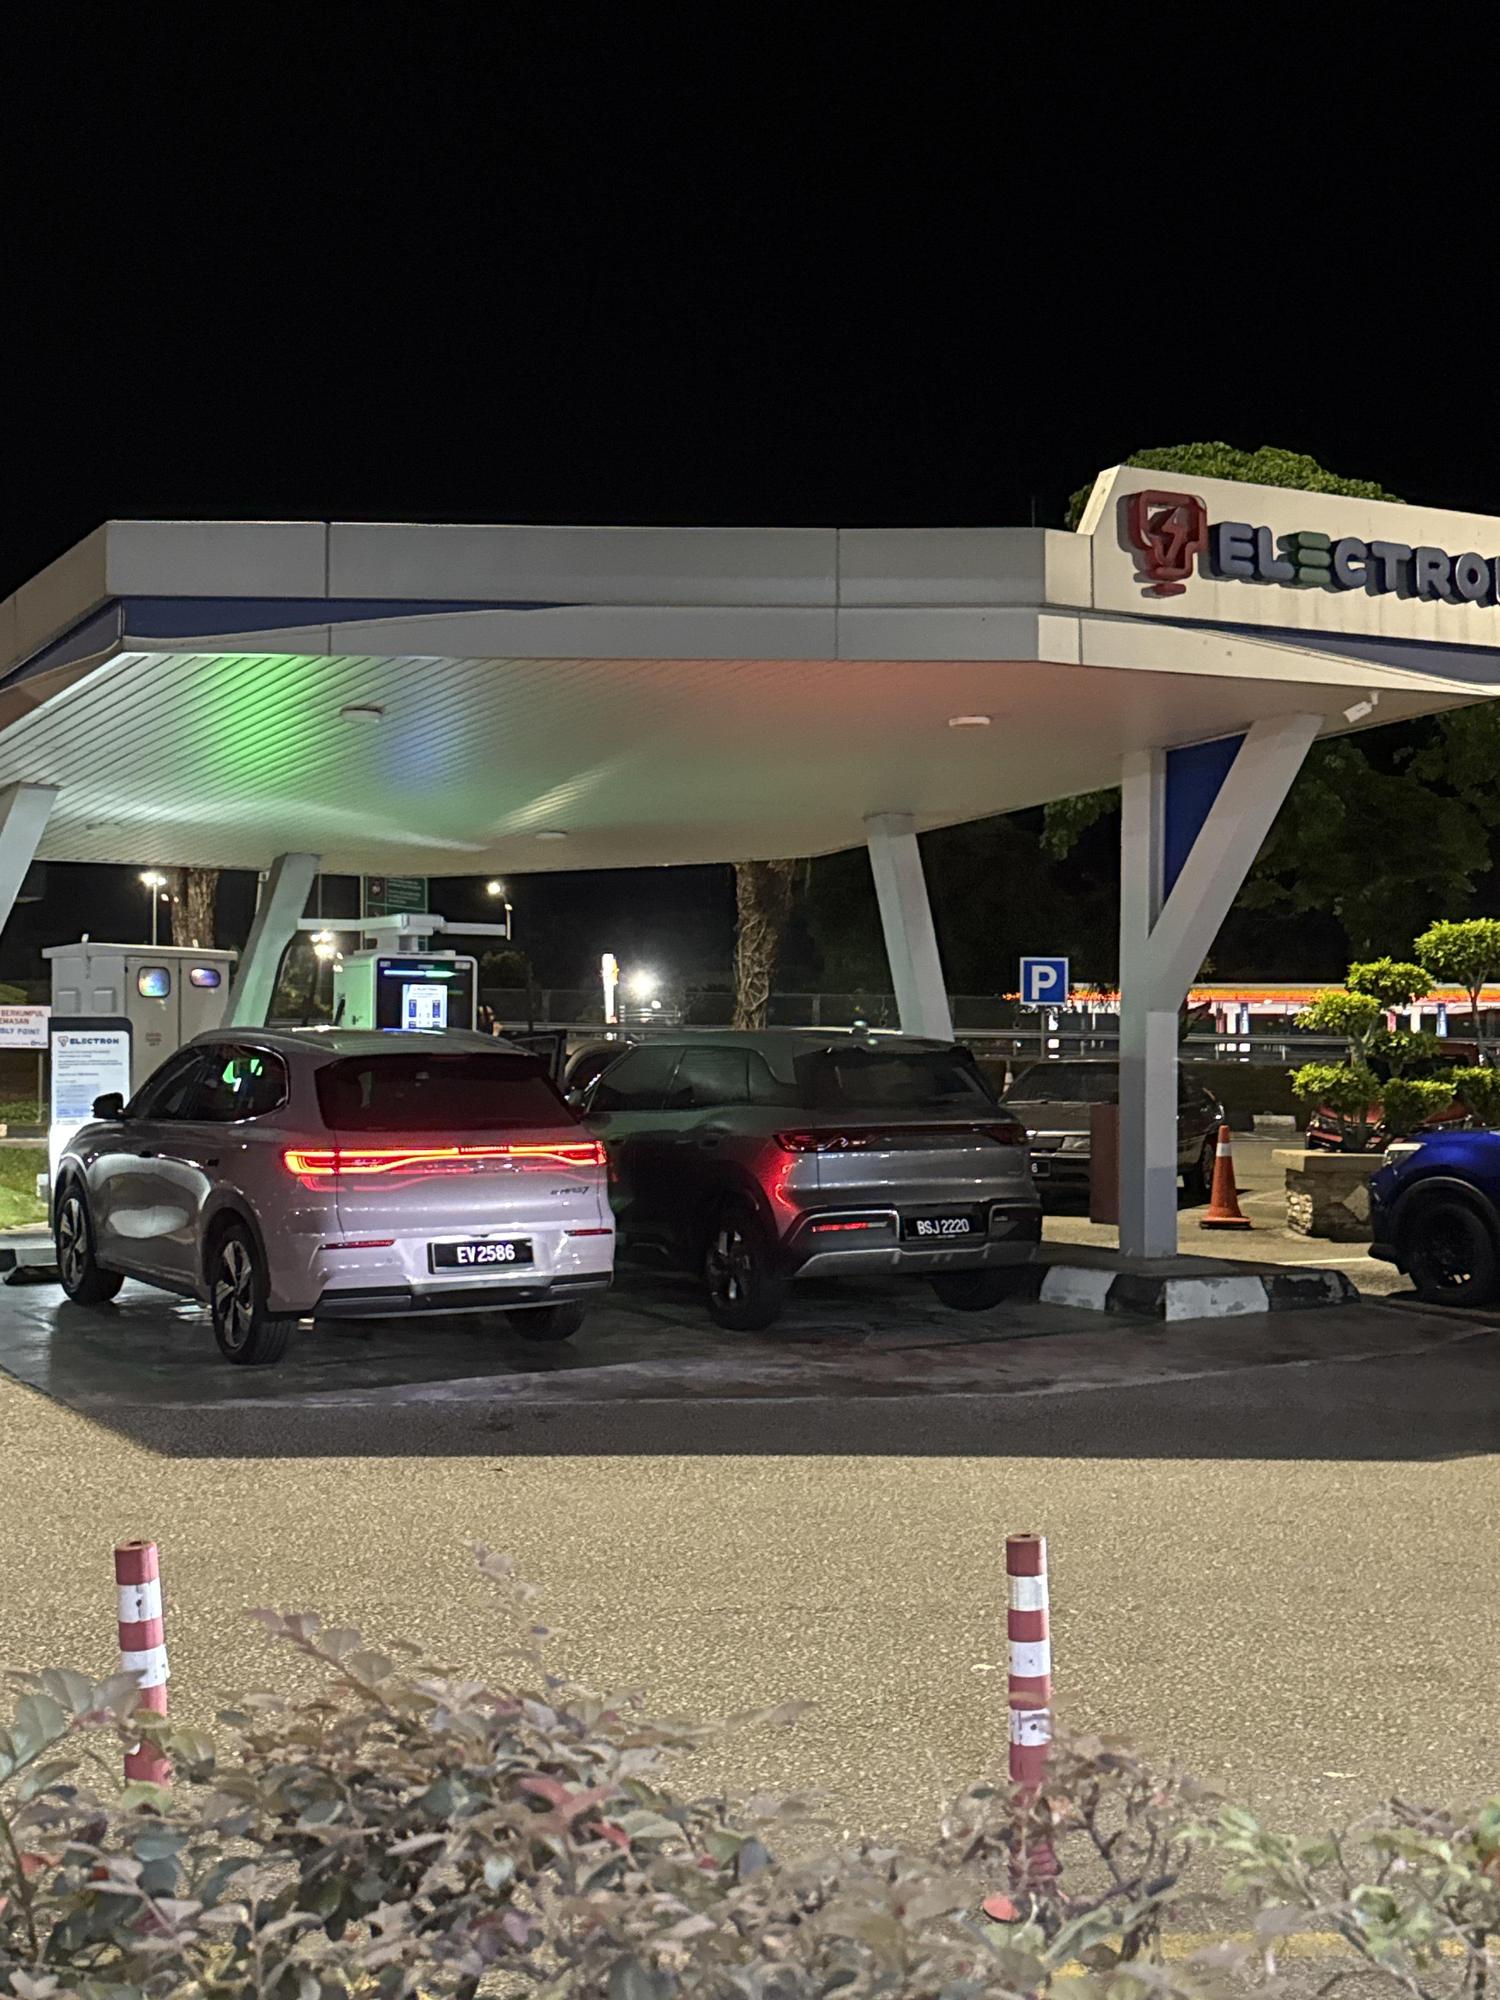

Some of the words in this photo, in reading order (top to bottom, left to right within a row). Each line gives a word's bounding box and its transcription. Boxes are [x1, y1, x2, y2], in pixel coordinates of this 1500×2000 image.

[1209, 520, 1500, 606] ELECTRO
[1031, 965, 1058, 1000] P
[17, 1028, 41, 1036] POINT
[916, 1220, 940, 1235] BSJ
[941, 1218, 970, 1234] 2220
